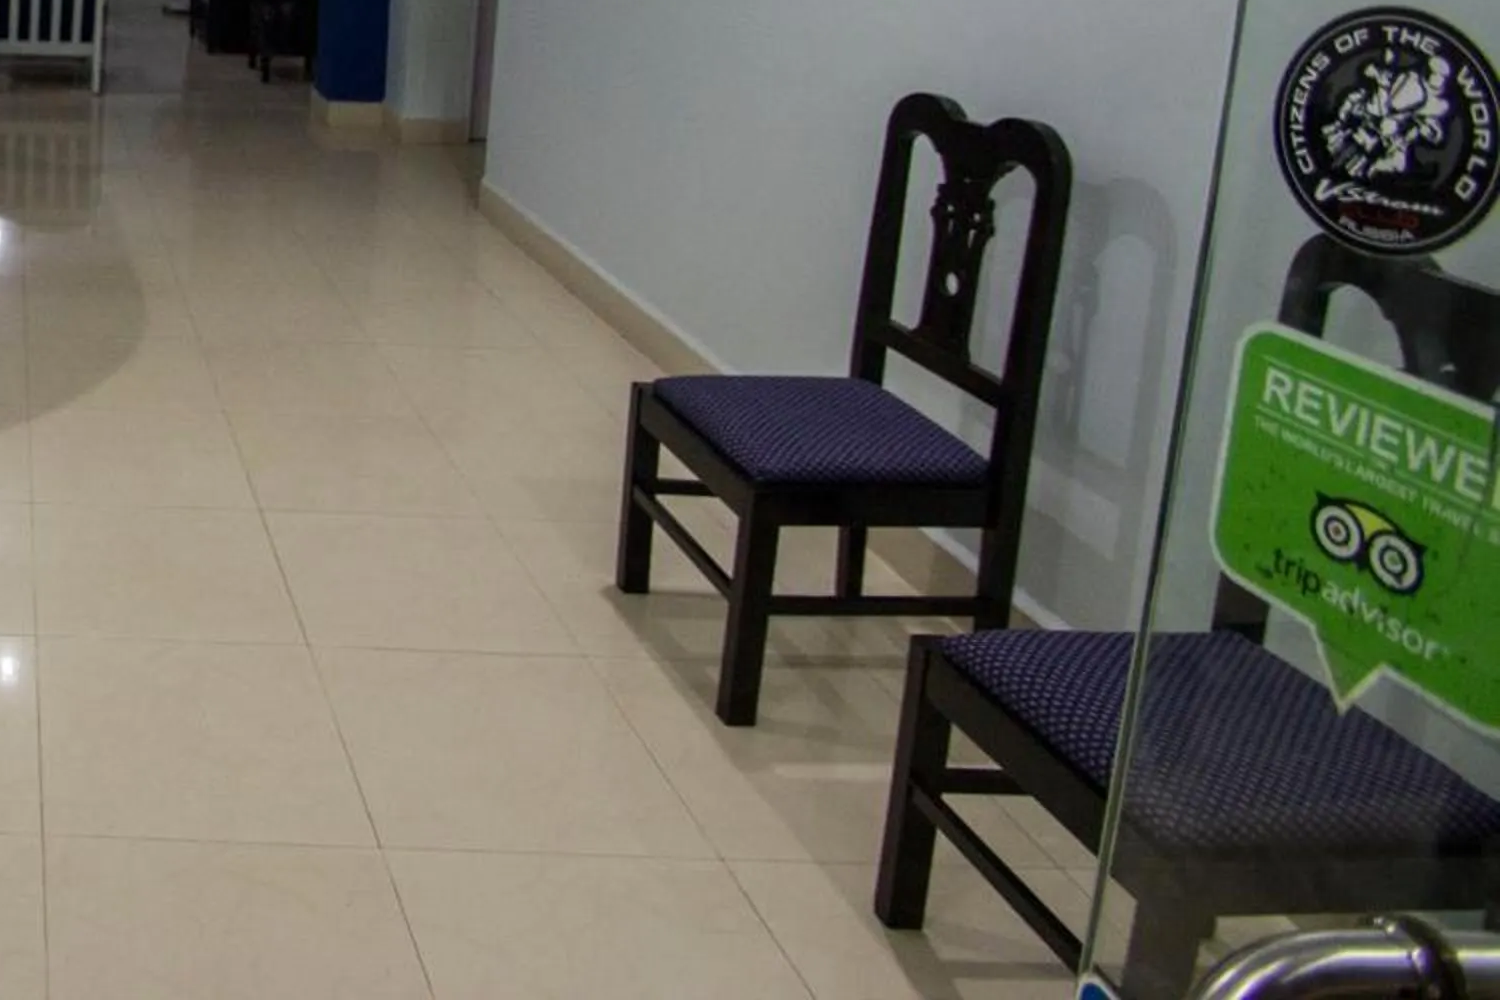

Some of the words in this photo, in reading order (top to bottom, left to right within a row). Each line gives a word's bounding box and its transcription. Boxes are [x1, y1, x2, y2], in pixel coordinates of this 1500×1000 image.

[1290, 52, 1330, 174] CITIZENS
[1334, 28, 1370, 54] OF
[1381, 26, 1440, 56] THE
[1455, 65, 1491, 200] WORLD
[1273, 548, 1441, 660] tripadvisor
